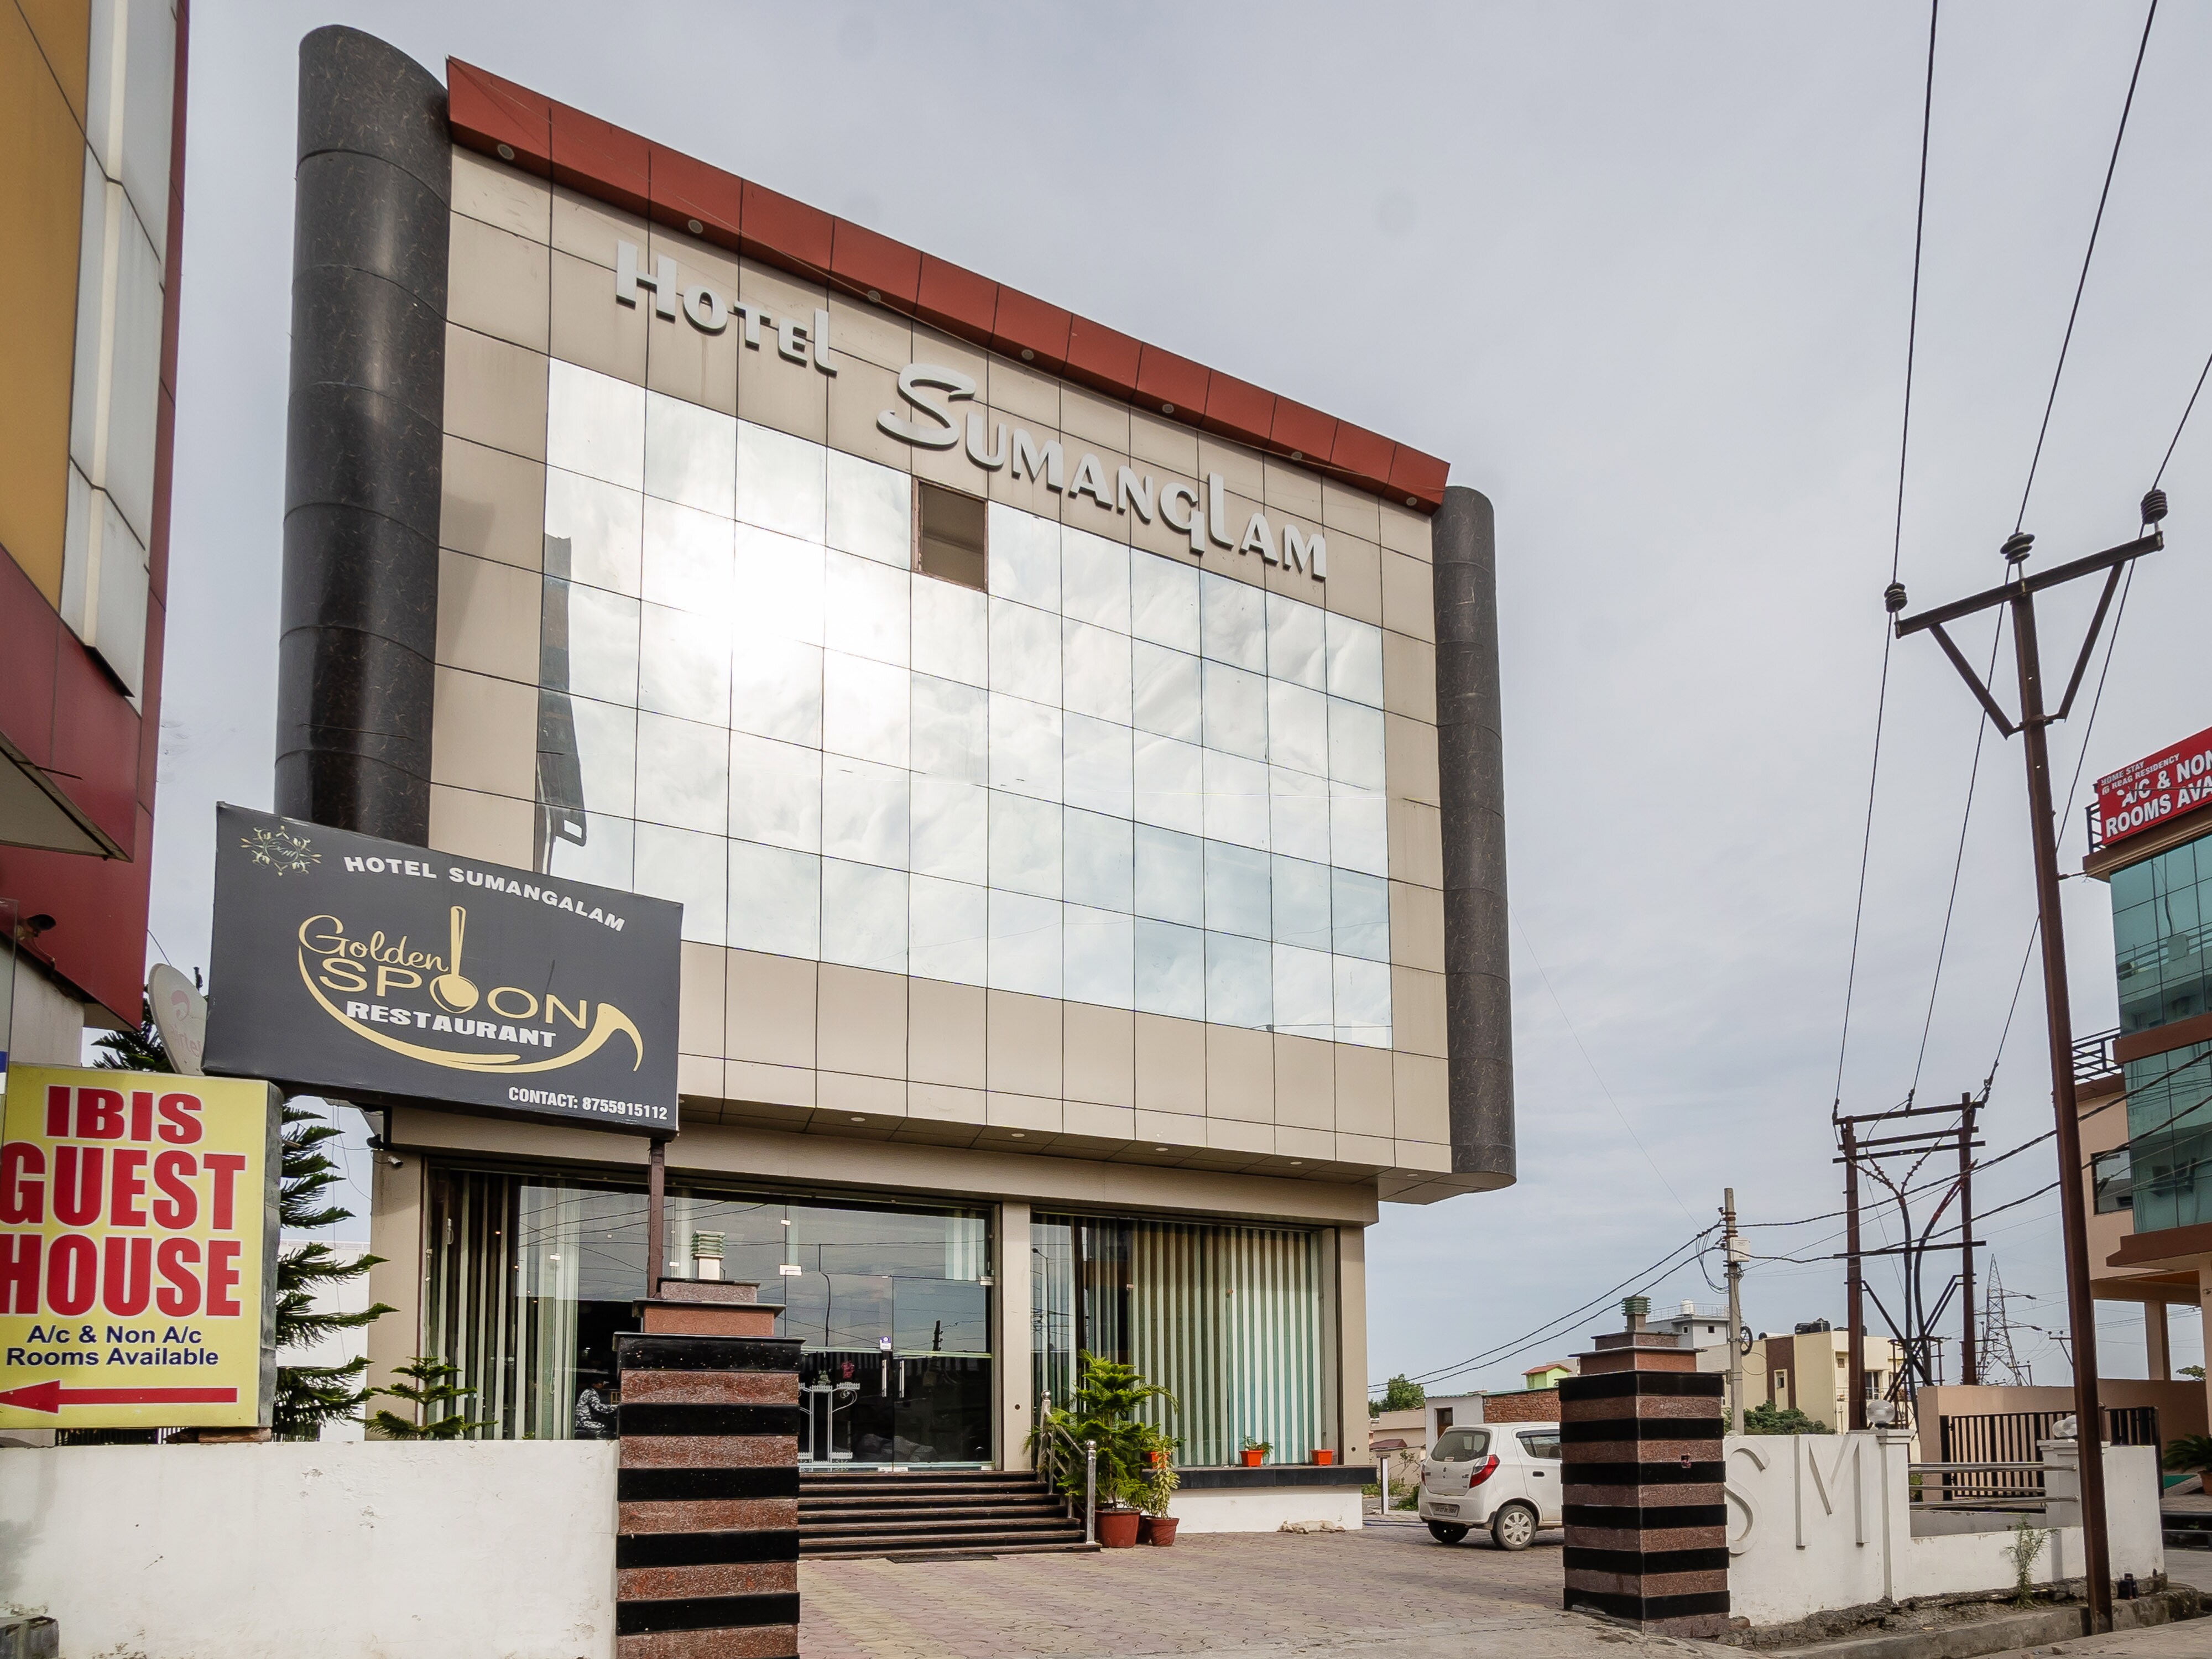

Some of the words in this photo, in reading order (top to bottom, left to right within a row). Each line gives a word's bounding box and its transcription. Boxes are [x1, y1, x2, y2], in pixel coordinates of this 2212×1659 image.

[877, 363, 1327, 580] SUMANGLAM
[2101, 769, 2124, 785] HOME
[2126, 761, 2145, 774] STAY
[2122, 779, 2150, 808] A/C
[2157, 770, 2171, 789] &
[2135, 753, 2179, 779] RESIDENCY
[2106, 794, 2171, 838] ROOMS
[344, 857, 437, 879] HOTEL
[448, 867, 625, 932] SUMANGALAM
[299, 915, 449, 973] Golden
[319, 957, 587, 1030] SPOON
[346, 1000, 556, 1048] RESTAURANT
[46, 1086, 203, 1144] IBIS
[508, 1087, 578, 1109] CONTACT:
[582, 1097, 667, 1120] 8755915112
[0, 1142, 246, 1230] GUEST
[0, 1233, 241, 1317] HOUSE
[6, 1348, 99, 1365] Rooms
[106, 1348, 218, 1365] Available
[27, 1325, 70, 1343] A/c
[79, 1325, 97, 1343] &
[106, 1326, 155, 1343] Non
[162, 1326, 202, 1344] A/c
